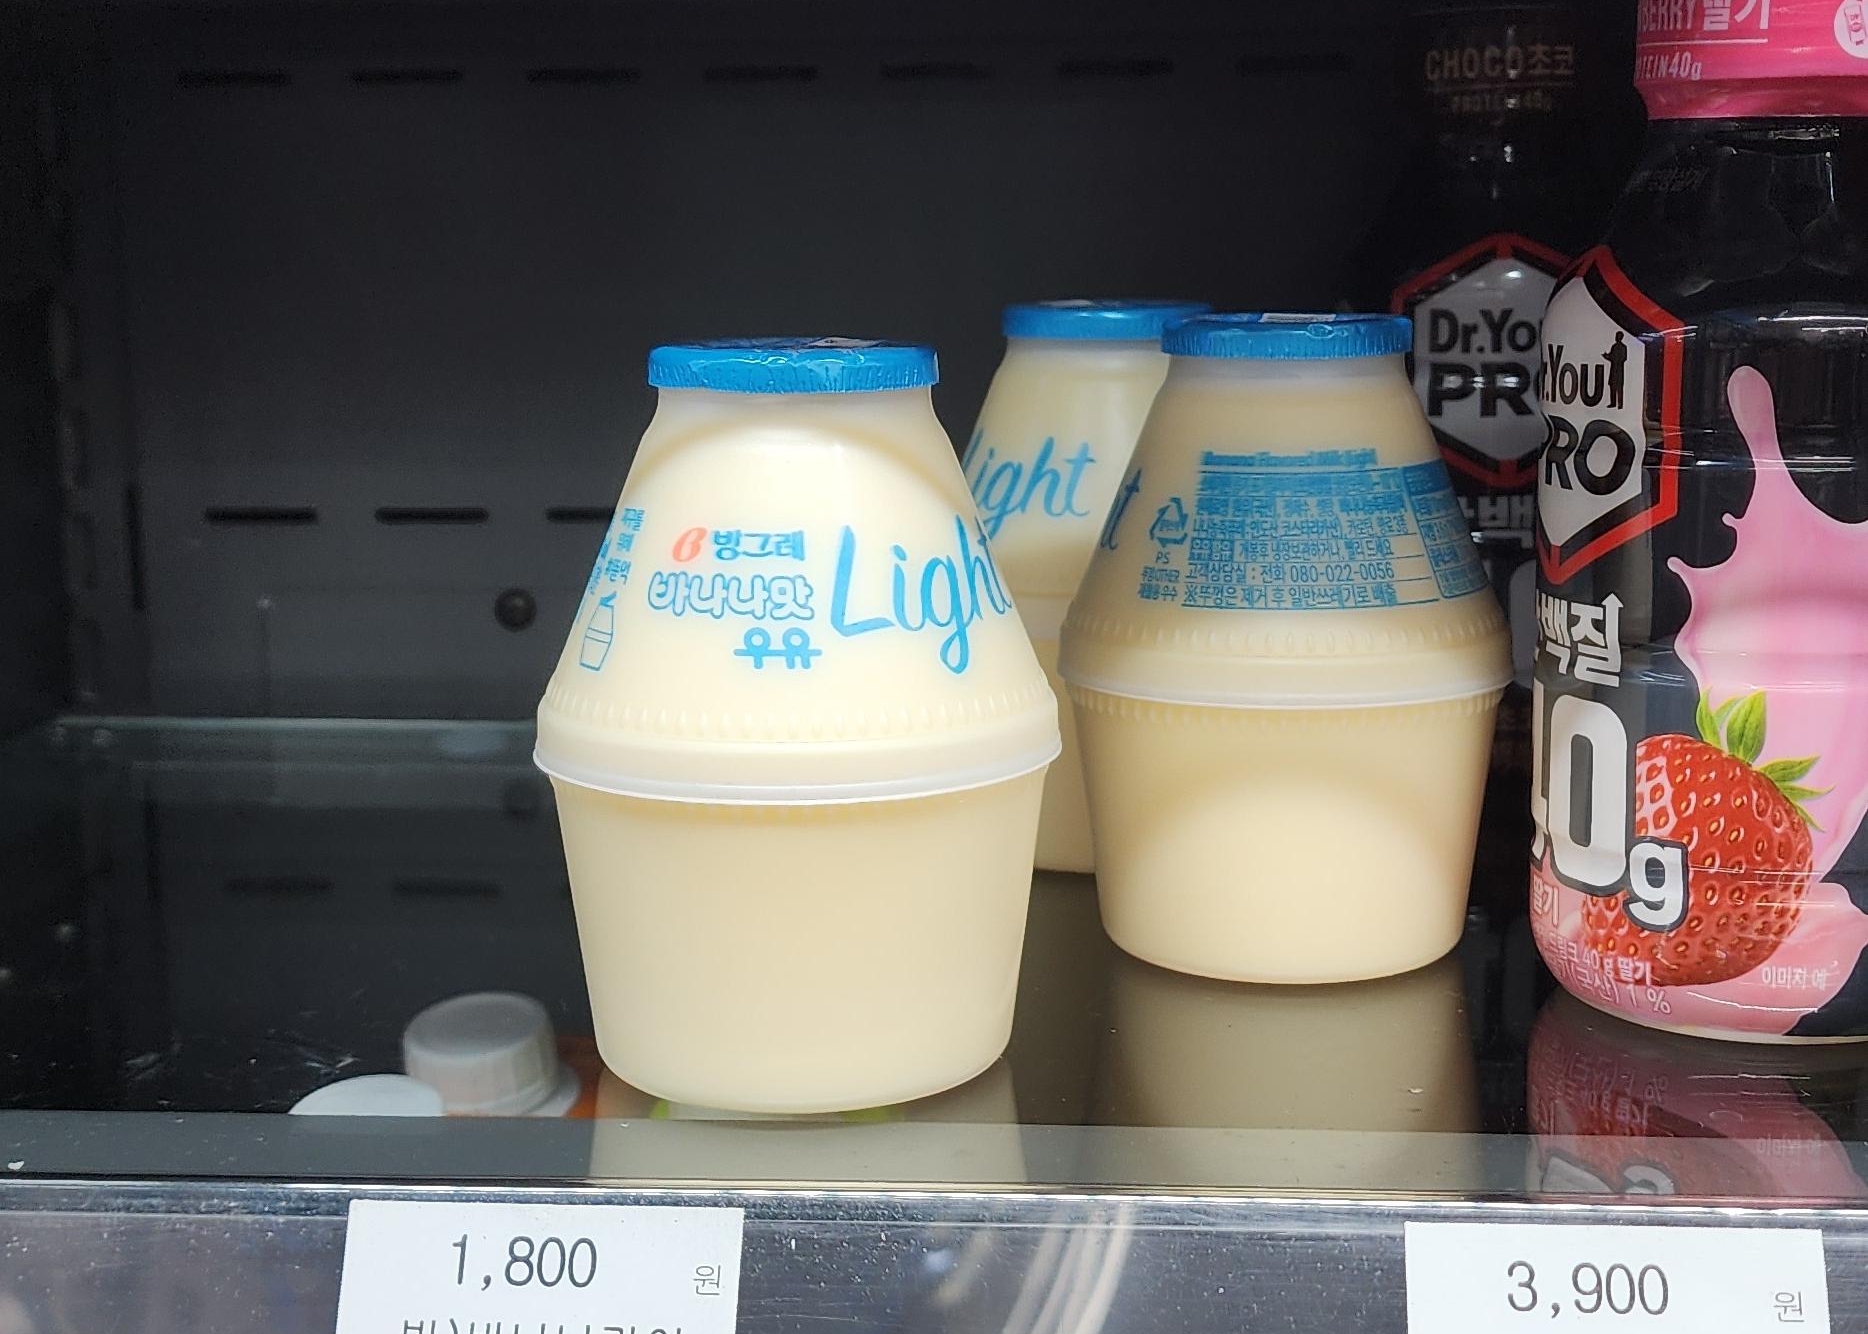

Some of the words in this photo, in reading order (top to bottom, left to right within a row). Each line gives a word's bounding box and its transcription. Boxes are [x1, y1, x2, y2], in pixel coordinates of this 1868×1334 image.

[1428, 362, 1540, 418] PR
[712, 528, 807, 562] 빙그레
[647, 570, 816, 621] 바나나맛
[732, 626, 823, 671] 우유
[452, 1233, 598, 1292] 1,800
[692, 1264, 722, 1296] 원
[1506, 1259, 1670, 1319] 3,900
[1772, 1289, 1806, 1324] 원
